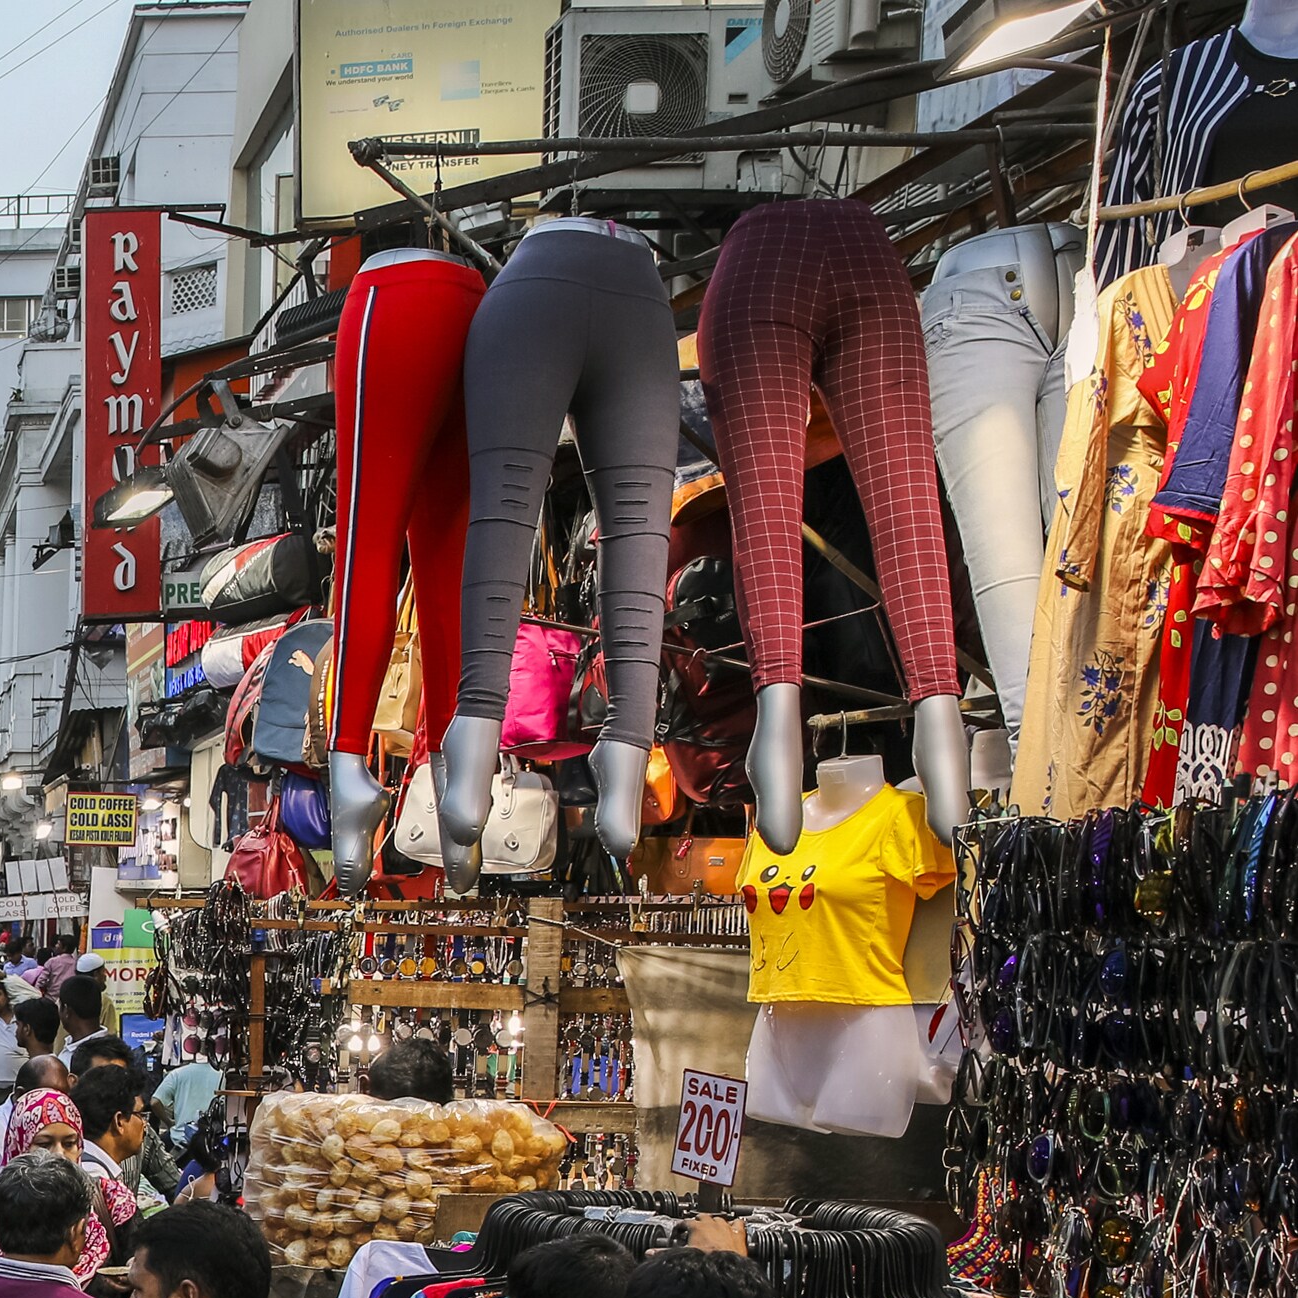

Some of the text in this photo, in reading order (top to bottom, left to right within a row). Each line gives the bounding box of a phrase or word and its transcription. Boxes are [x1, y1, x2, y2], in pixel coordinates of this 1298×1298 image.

[335, 16, 514, 38] Authorised Dealers In Foreign Exchange
[344, 61, 408, 75] HDFC BANK
[325, 73, 414, 87] We understand your world
[419, 157, 479, 169] TRANSFER
[70, 798, 134, 811] COLD COFFEE
[70, 813, 132, 827] COLD LASSI
[48, 904, 81, 913] COFFEE
[688, 1078, 738, 1104] SALE
[681, 1158, 718, 1177] FIXED
